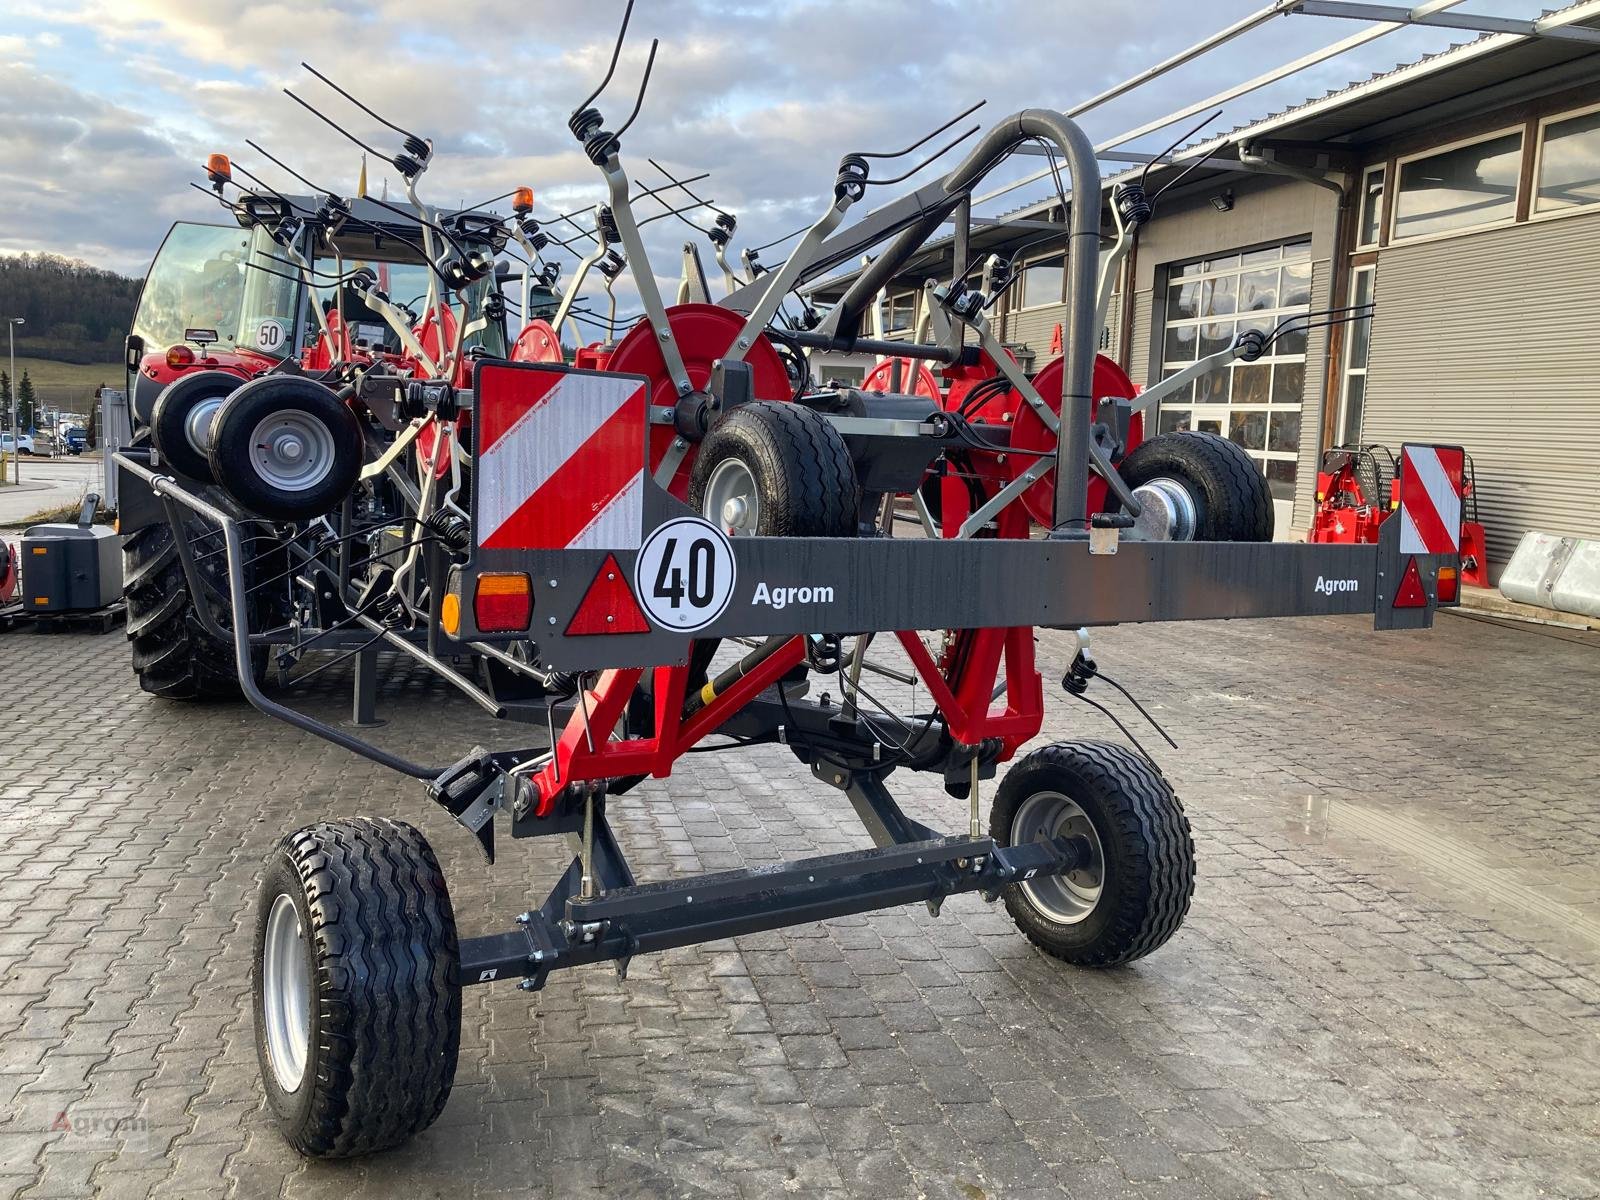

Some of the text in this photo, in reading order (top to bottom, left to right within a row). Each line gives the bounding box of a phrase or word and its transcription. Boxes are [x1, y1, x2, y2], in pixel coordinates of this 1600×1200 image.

[260, 326, 278, 345] 50
[653, 538, 715, 608] 40
[751, 582, 834, 609] Agrom
[1314, 575, 1358, 596] Agrom
